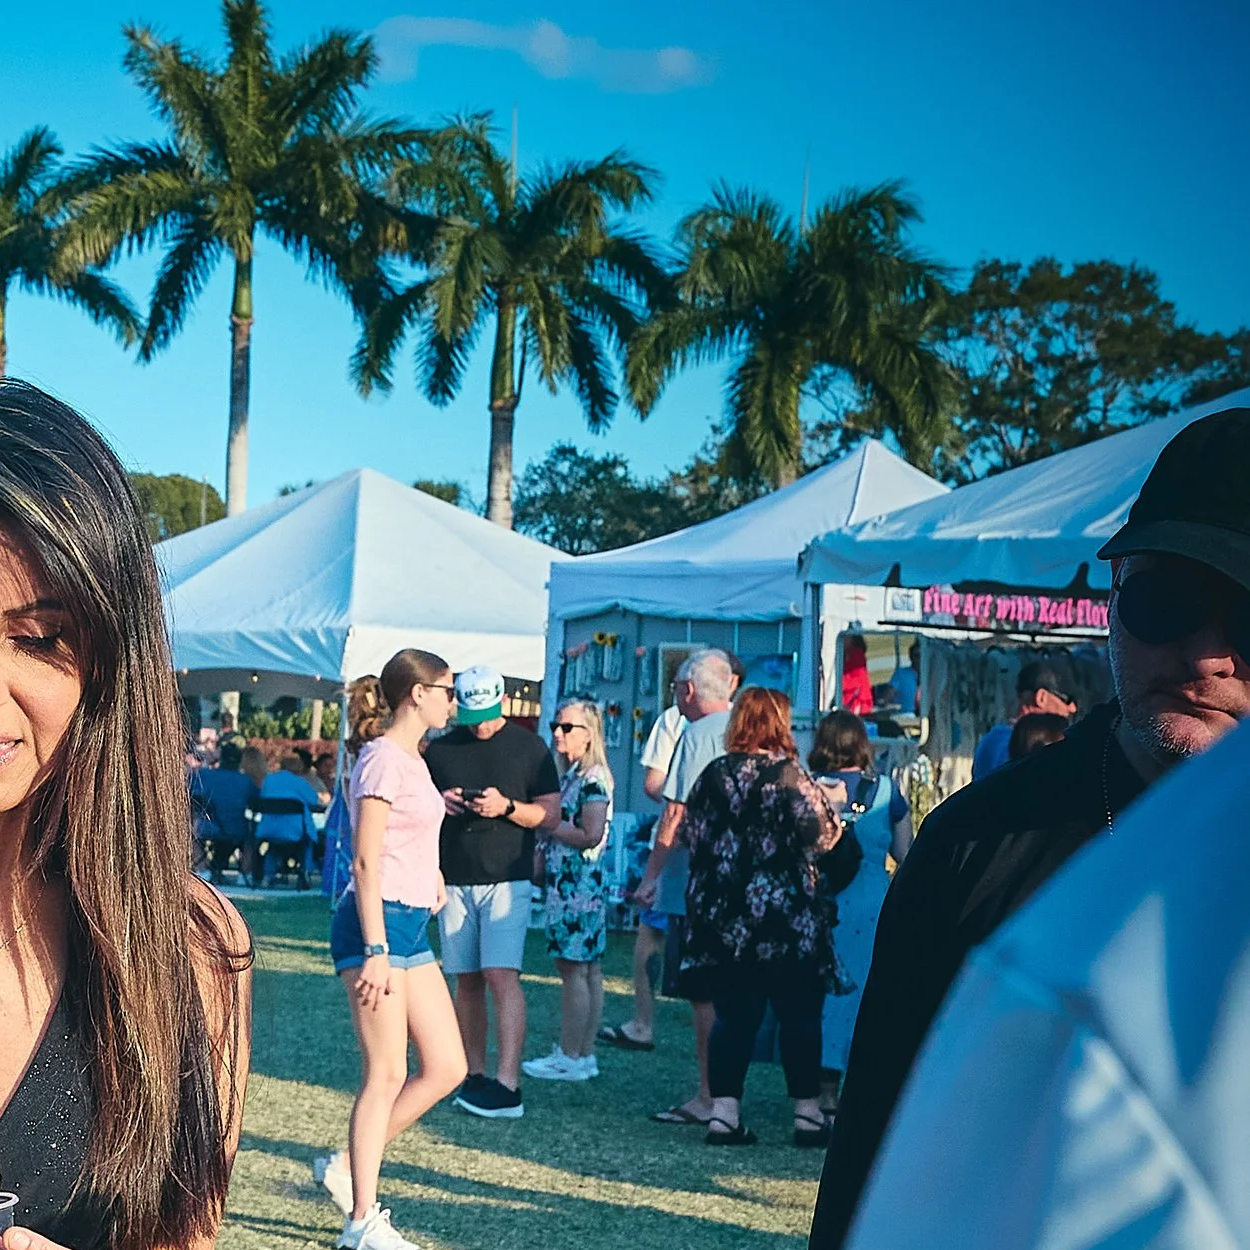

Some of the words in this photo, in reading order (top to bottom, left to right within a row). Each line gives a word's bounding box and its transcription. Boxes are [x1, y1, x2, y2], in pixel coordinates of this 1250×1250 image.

[924, 585, 961, 615] Fine
[963, 593, 993, 618] Art
[997, 595, 1035, 622] with
[1038, 596, 1074, 625] Real
